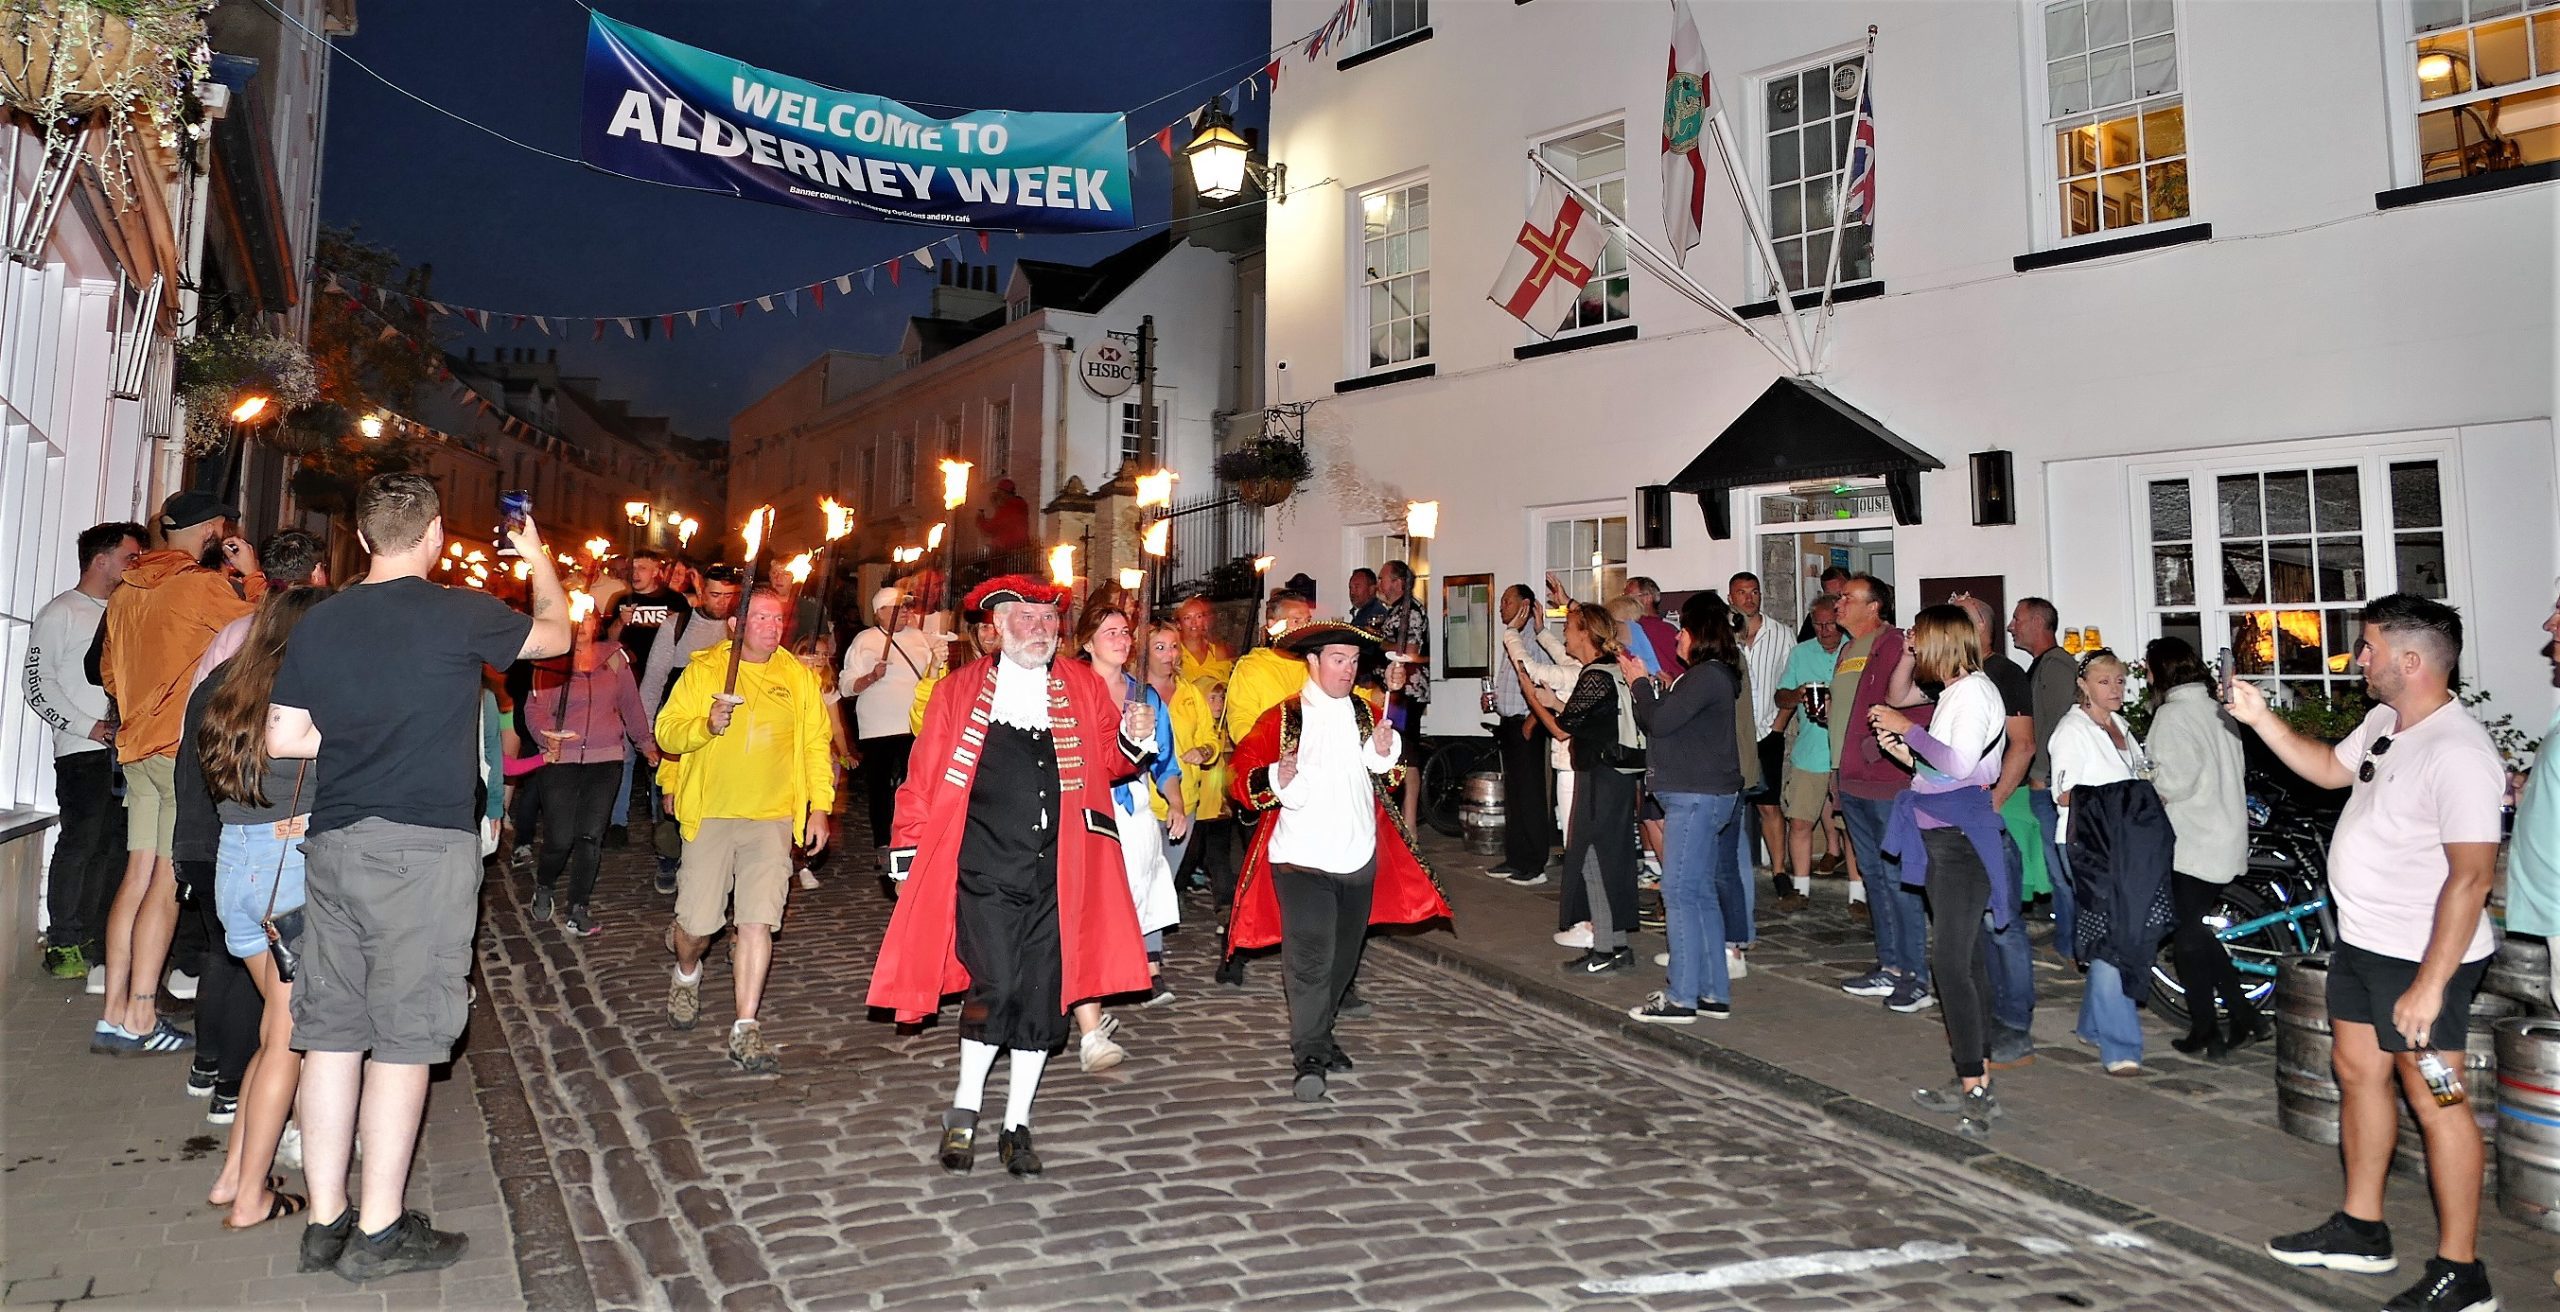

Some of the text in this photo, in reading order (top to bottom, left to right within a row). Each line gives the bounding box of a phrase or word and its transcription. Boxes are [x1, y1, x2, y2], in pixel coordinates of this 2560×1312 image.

[732, 76, 1009, 155] WELCOME TO
[607, 89, 1113, 211] ALDERNEY WEEK
[789, 185, 820, 197] Banner
[1087, 361, 1132, 380] HSBC
[622, 604, 668, 624] ANS
[25, 646, 47, 707] Angeles
